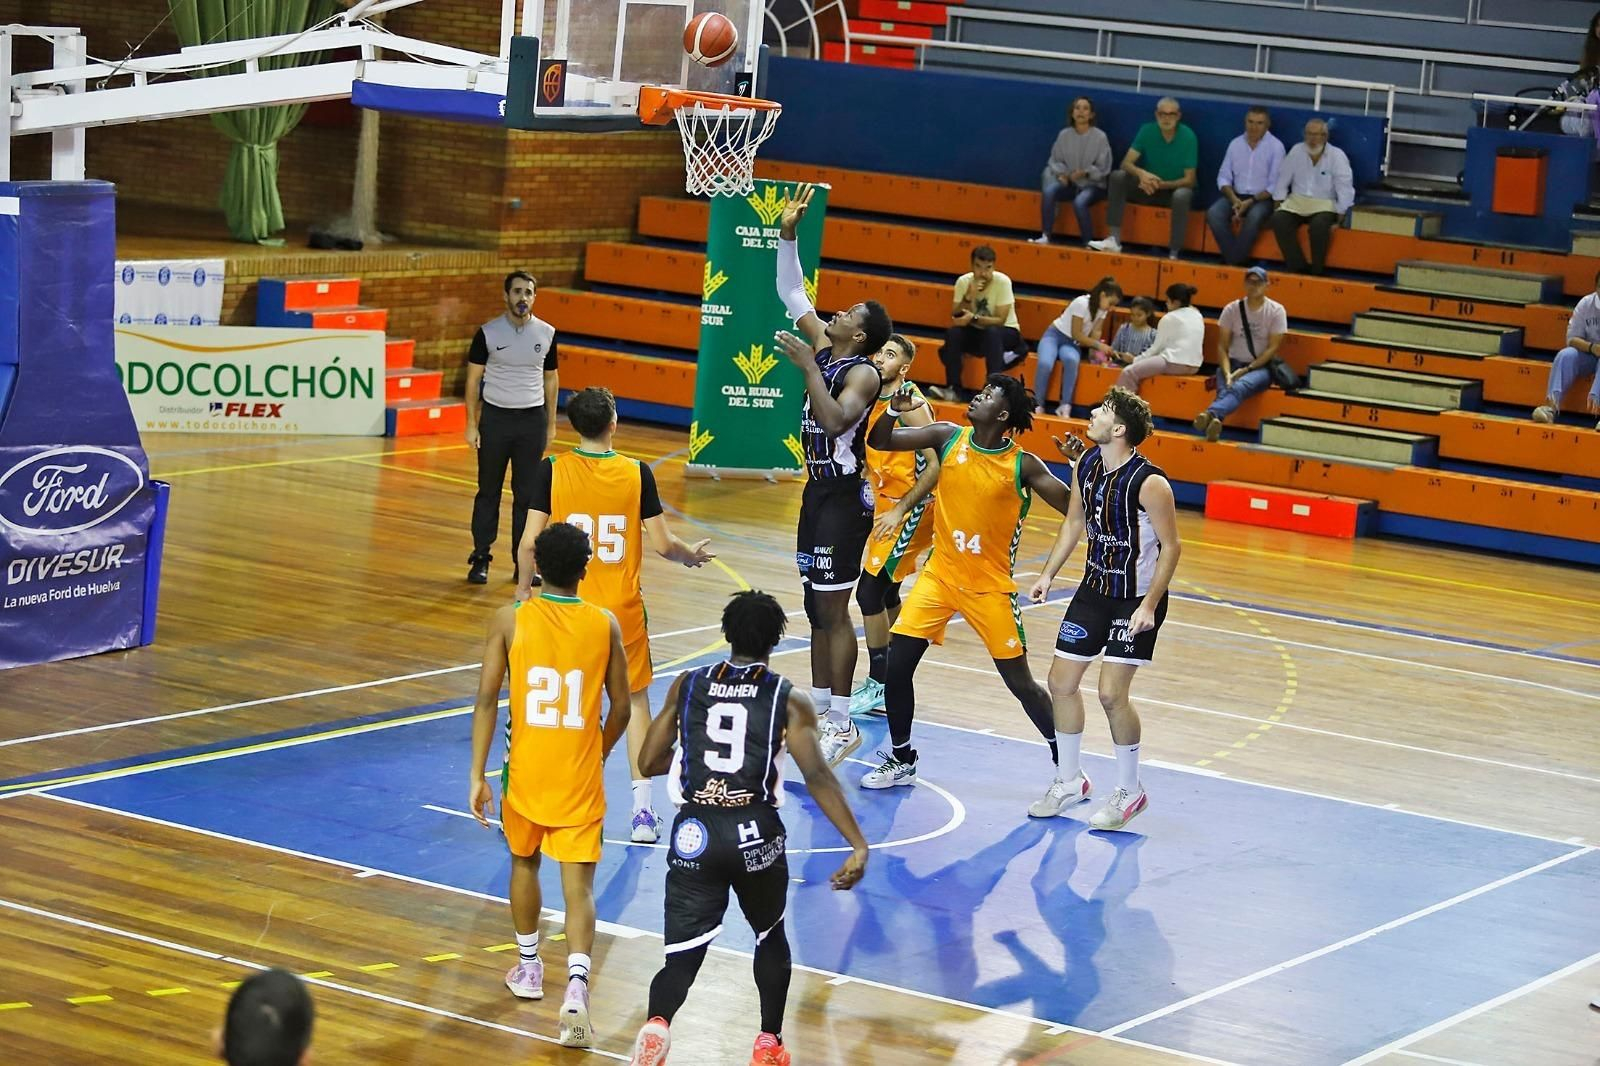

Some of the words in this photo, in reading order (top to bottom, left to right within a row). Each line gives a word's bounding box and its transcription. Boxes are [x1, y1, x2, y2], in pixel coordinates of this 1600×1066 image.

[735, 226, 760, 237] CAJA
[742, 238, 764, 248] DEL
[1458, 302, 1474, 315] 10
[701, 315, 724, 326] SUR
[115, 356, 373, 399] DOCOLCHÓN
[722, 386, 746, 396] CAJA
[749, 387, 783, 397] RURAL
[728, 397, 750, 407] DEL
[752, 398, 774, 408] SUR
[159, 405, 203, 415] Distribuidor
[225, 402, 284, 418] FLEX
[1368, 408, 1378, 422] 8
[146, 420, 299, 432] www.todocolchon.es
[23, 464, 109, 516] Ford
[952, 530, 981, 554] 34
[8, 544, 125, 585] DIVESUR
[4, 597, 17, 608] La
[19, 592, 47, 606] nueva
[49, 586, 72, 601] Ford
[74, 585, 86, 596] de
[88, 581, 120, 595] Huelva
[1061, 623, 1081, 636] Ford
[526, 666, 584, 729] 21
[708, 683, 758, 698] BOAHEN
[704, 702, 748, 774] 9
[737, 820, 760, 843] H
[745, 858, 758, 867] DE
